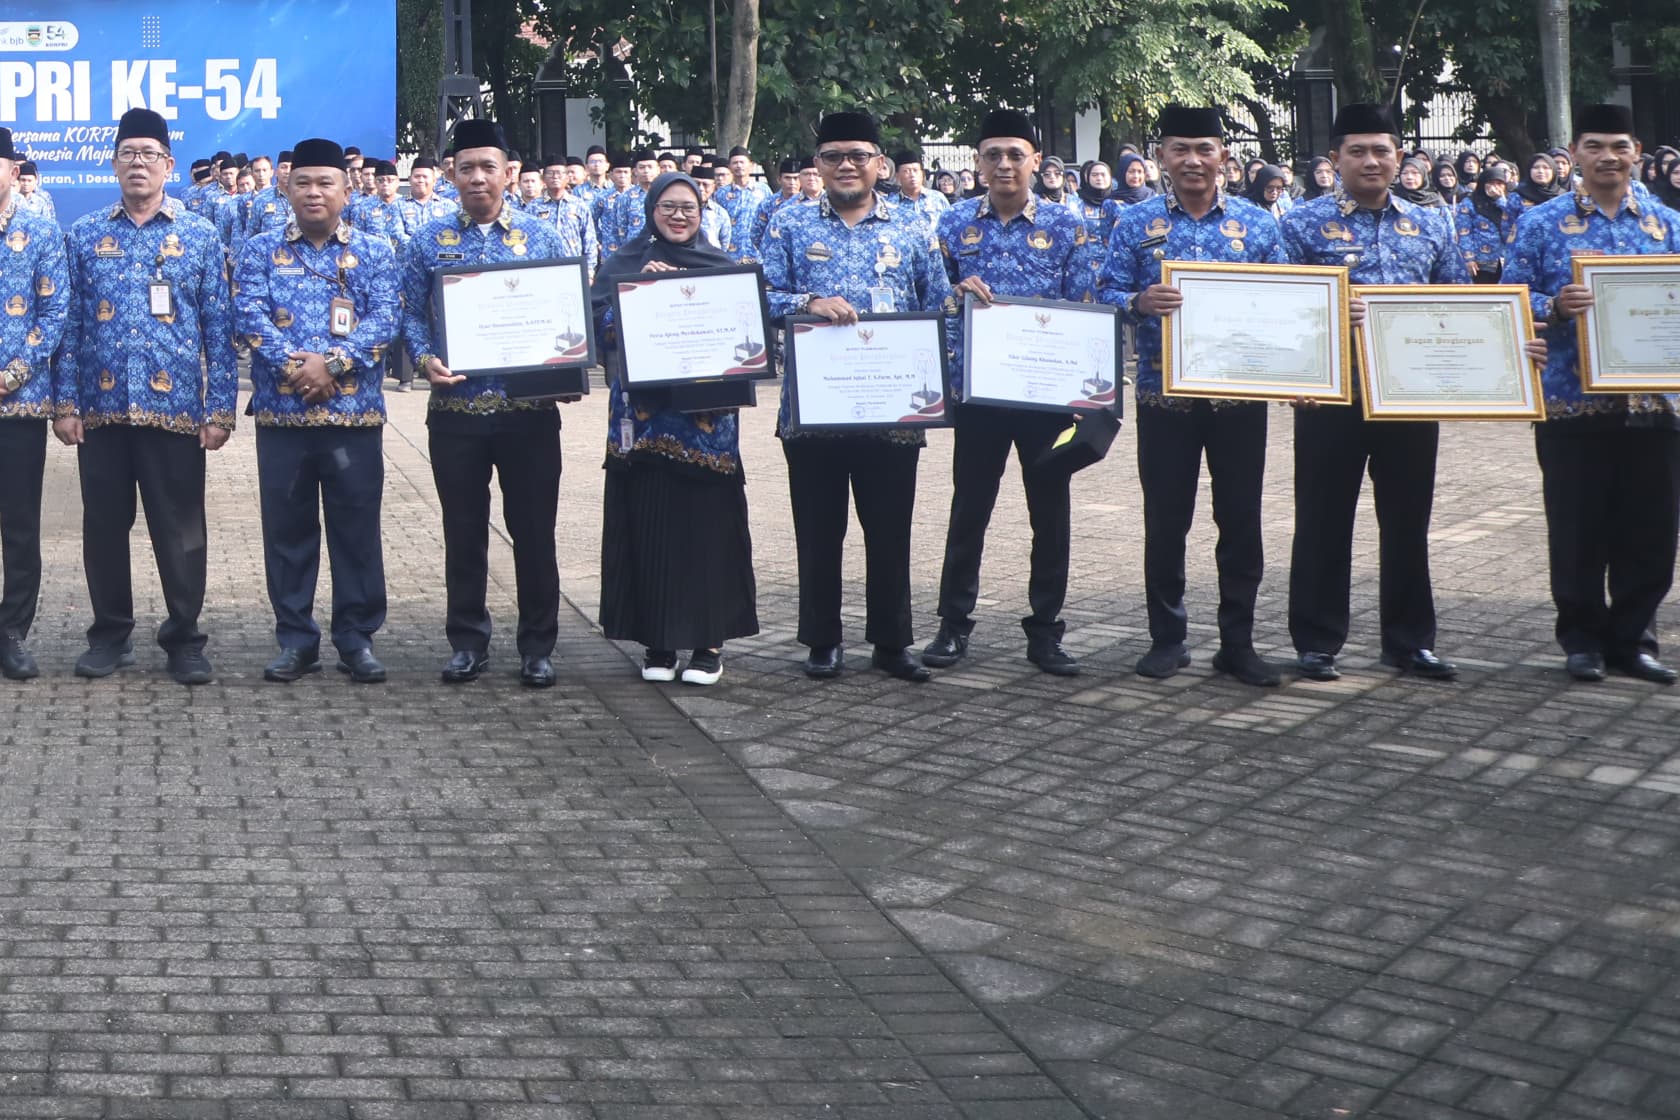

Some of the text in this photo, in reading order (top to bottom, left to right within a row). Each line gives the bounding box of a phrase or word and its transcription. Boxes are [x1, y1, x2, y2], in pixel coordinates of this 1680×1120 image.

[10, 36, 24, 46] bjb
[111, 58, 282, 120] KE-54
[64, 126, 119, 143] KORP
[13, 144, 115, 166] donesia Maju
